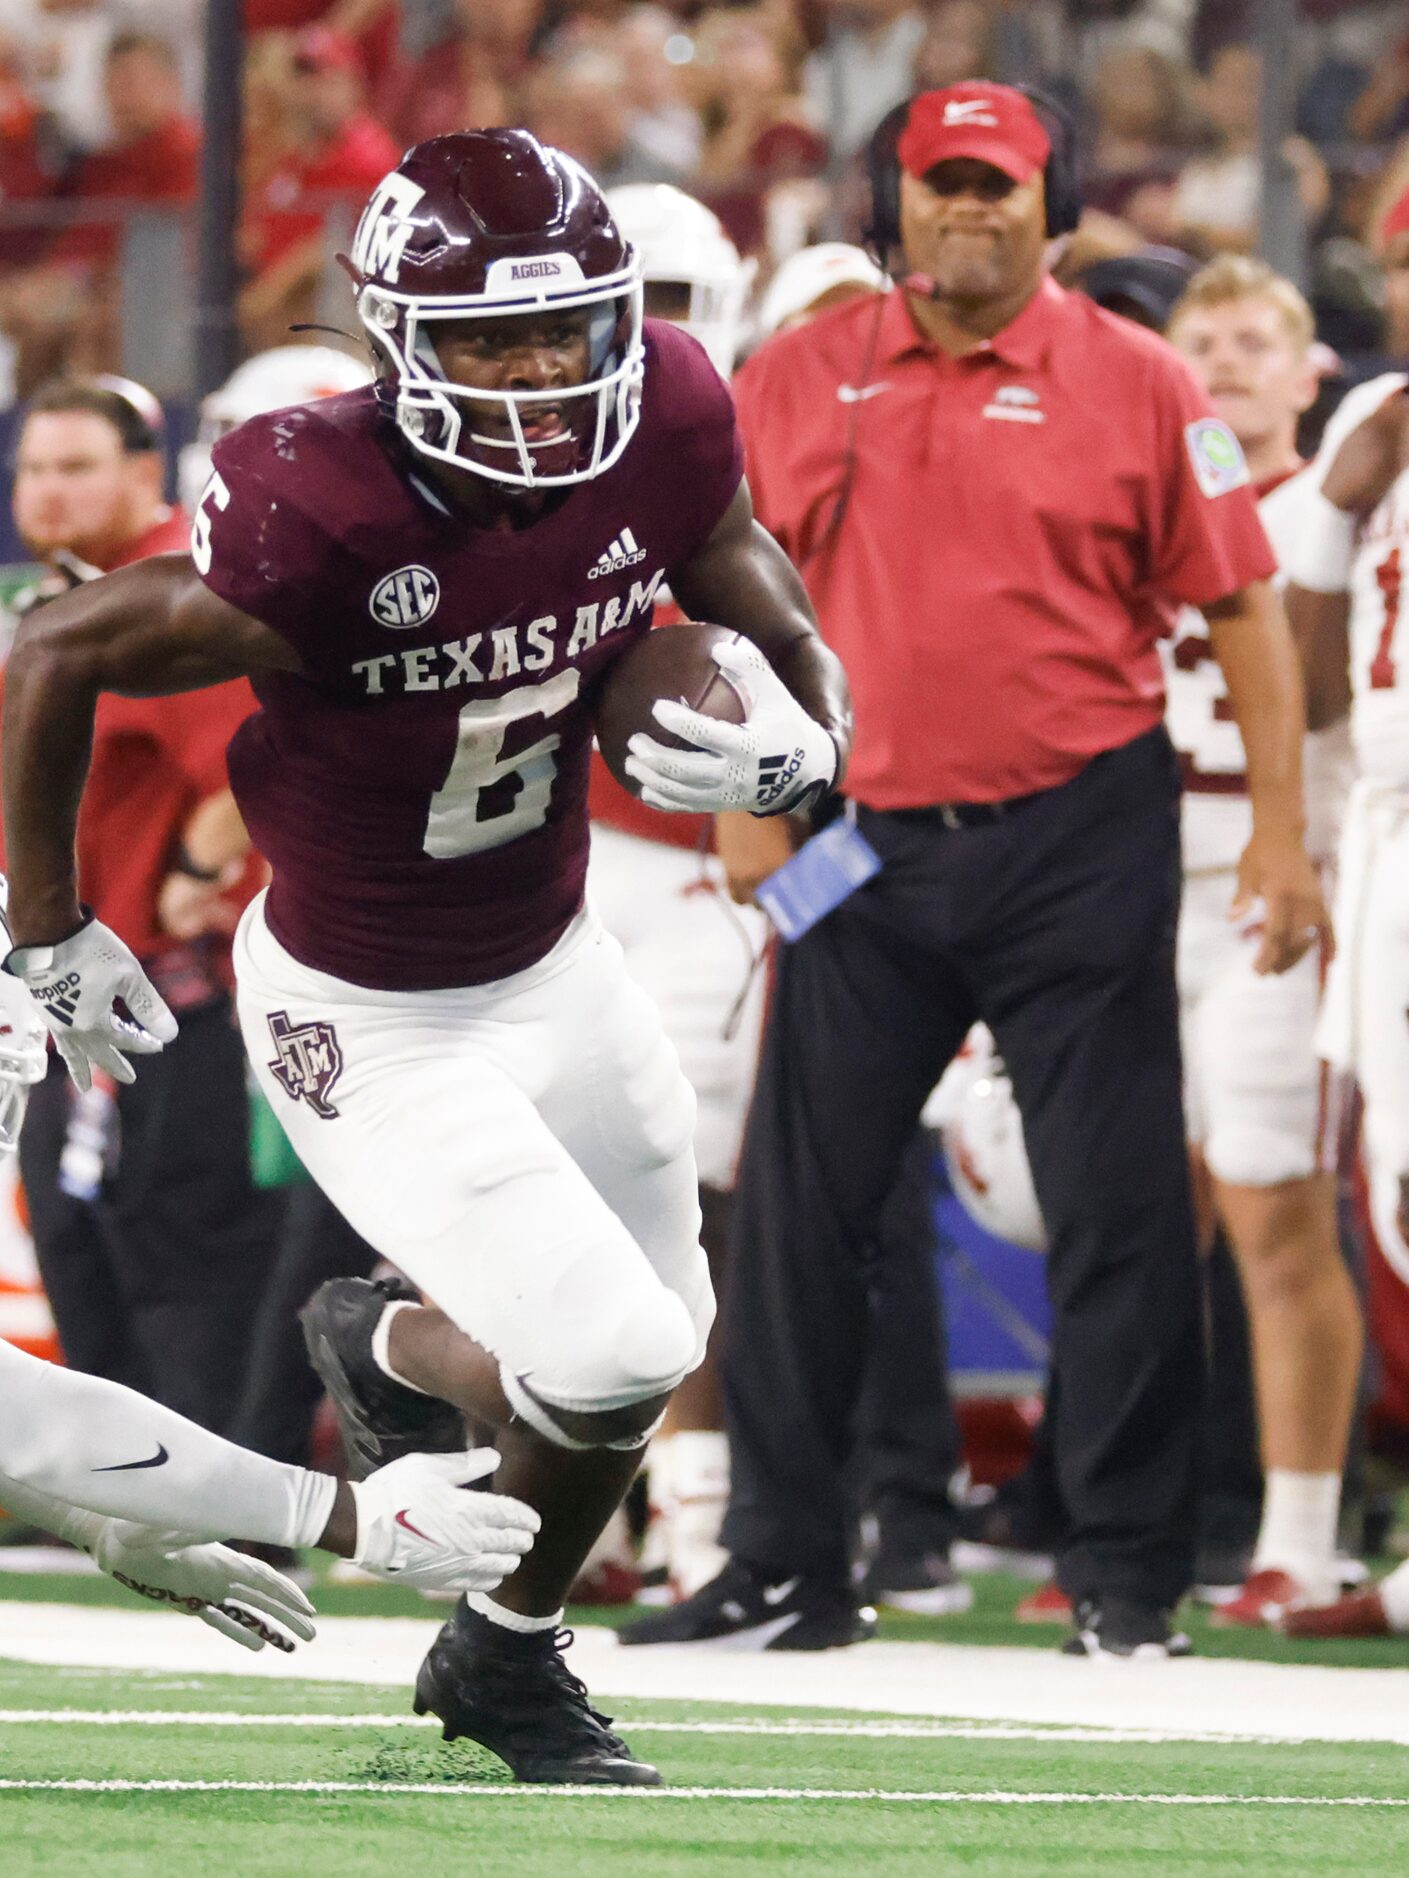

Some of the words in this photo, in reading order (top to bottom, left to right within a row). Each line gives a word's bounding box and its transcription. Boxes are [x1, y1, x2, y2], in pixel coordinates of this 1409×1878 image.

[511, 261, 561, 280] AGGIES
[587, 548, 646, 579] adidas
[376, 569, 434, 624] SEC
[351, 614, 558, 694] TEXAS
[566, 567, 666, 658] A&M
[423, 667, 581, 859] 6
[758, 747, 805, 806] adidas
